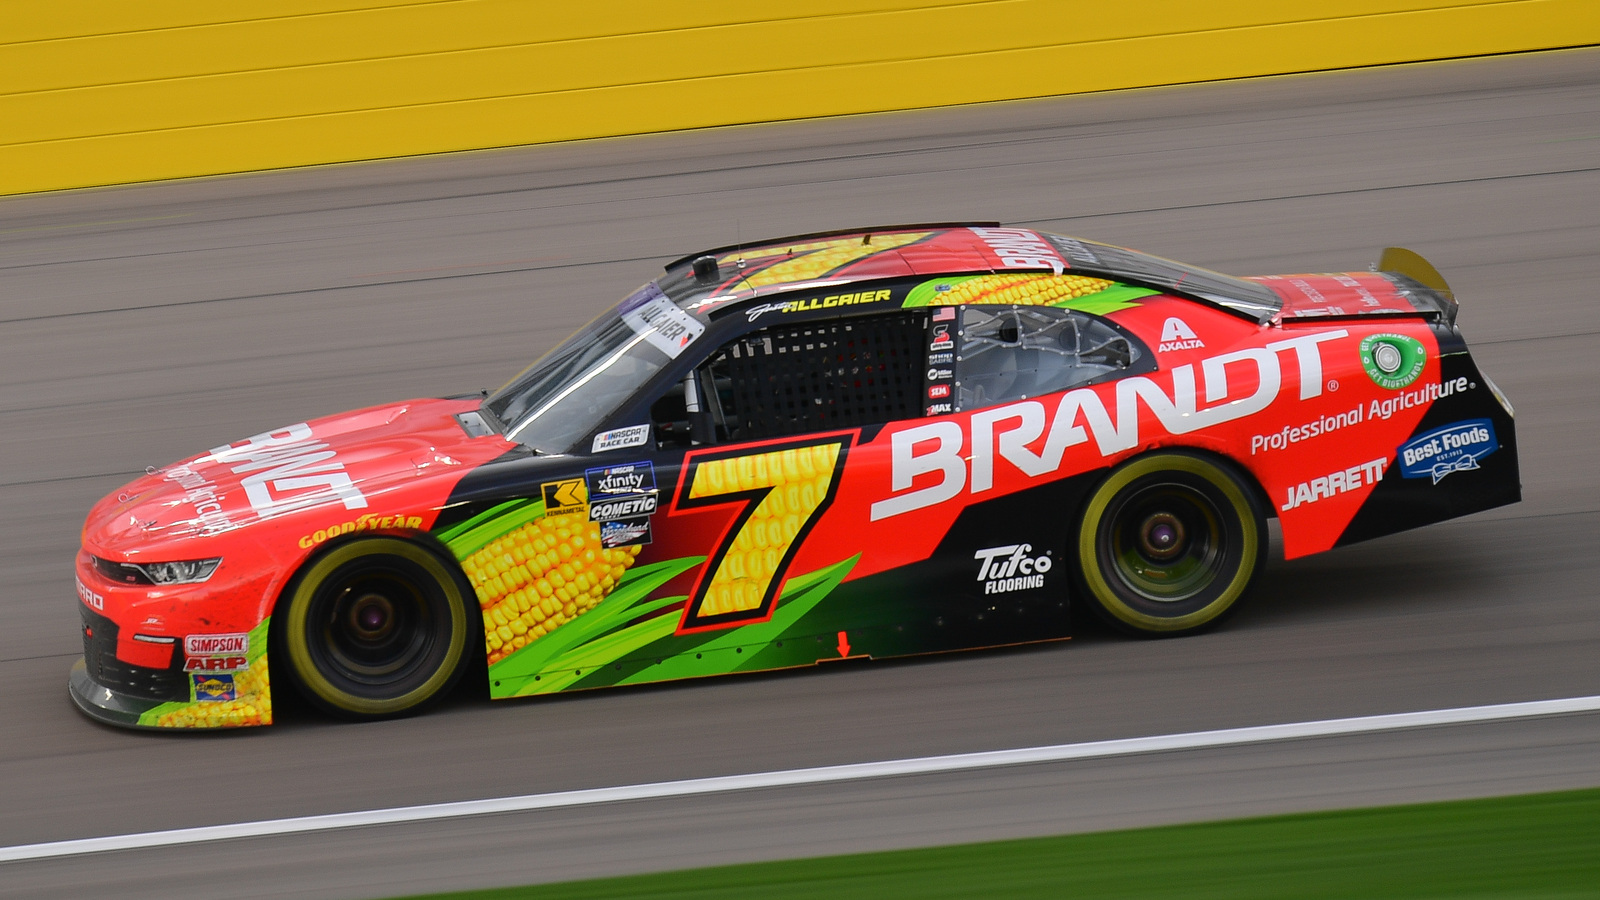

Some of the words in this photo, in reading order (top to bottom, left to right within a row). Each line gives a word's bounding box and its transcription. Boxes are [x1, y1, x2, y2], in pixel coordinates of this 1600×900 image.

[782, 289, 892, 313] ALLGAIER
[1158, 339, 1205, 353] AXALTA
[931, 387, 947, 396] SEM
[870, 330, 1349, 522] BRANDT
[1251, 404, 1363, 455] Professional
[1368, 376, 1468, 420] Agriculture
[600, 440, 621, 448] RACE
[623, 436, 640, 444] CAR
[609, 428, 642, 440] NASCAR
[1403, 439, 1443, 467] Best
[1441, 427, 1490, 451] Foods
[598, 473, 644, 489] xfinity
[1282, 457, 1387, 511] JARRETT
[591, 496, 656, 518] COMETIC
[298, 513, 423, 549] GOODYEAR
[675, 432, 854, 629] 7
[974, 543, 1052, 581] Tufco
[985, 574, 1044, 595] FLOORING
[191, 638, 243, 651] SIMPSON
[186, 656, 247, 669] ARP
[196, 683, 234, 692] SUNOCO
